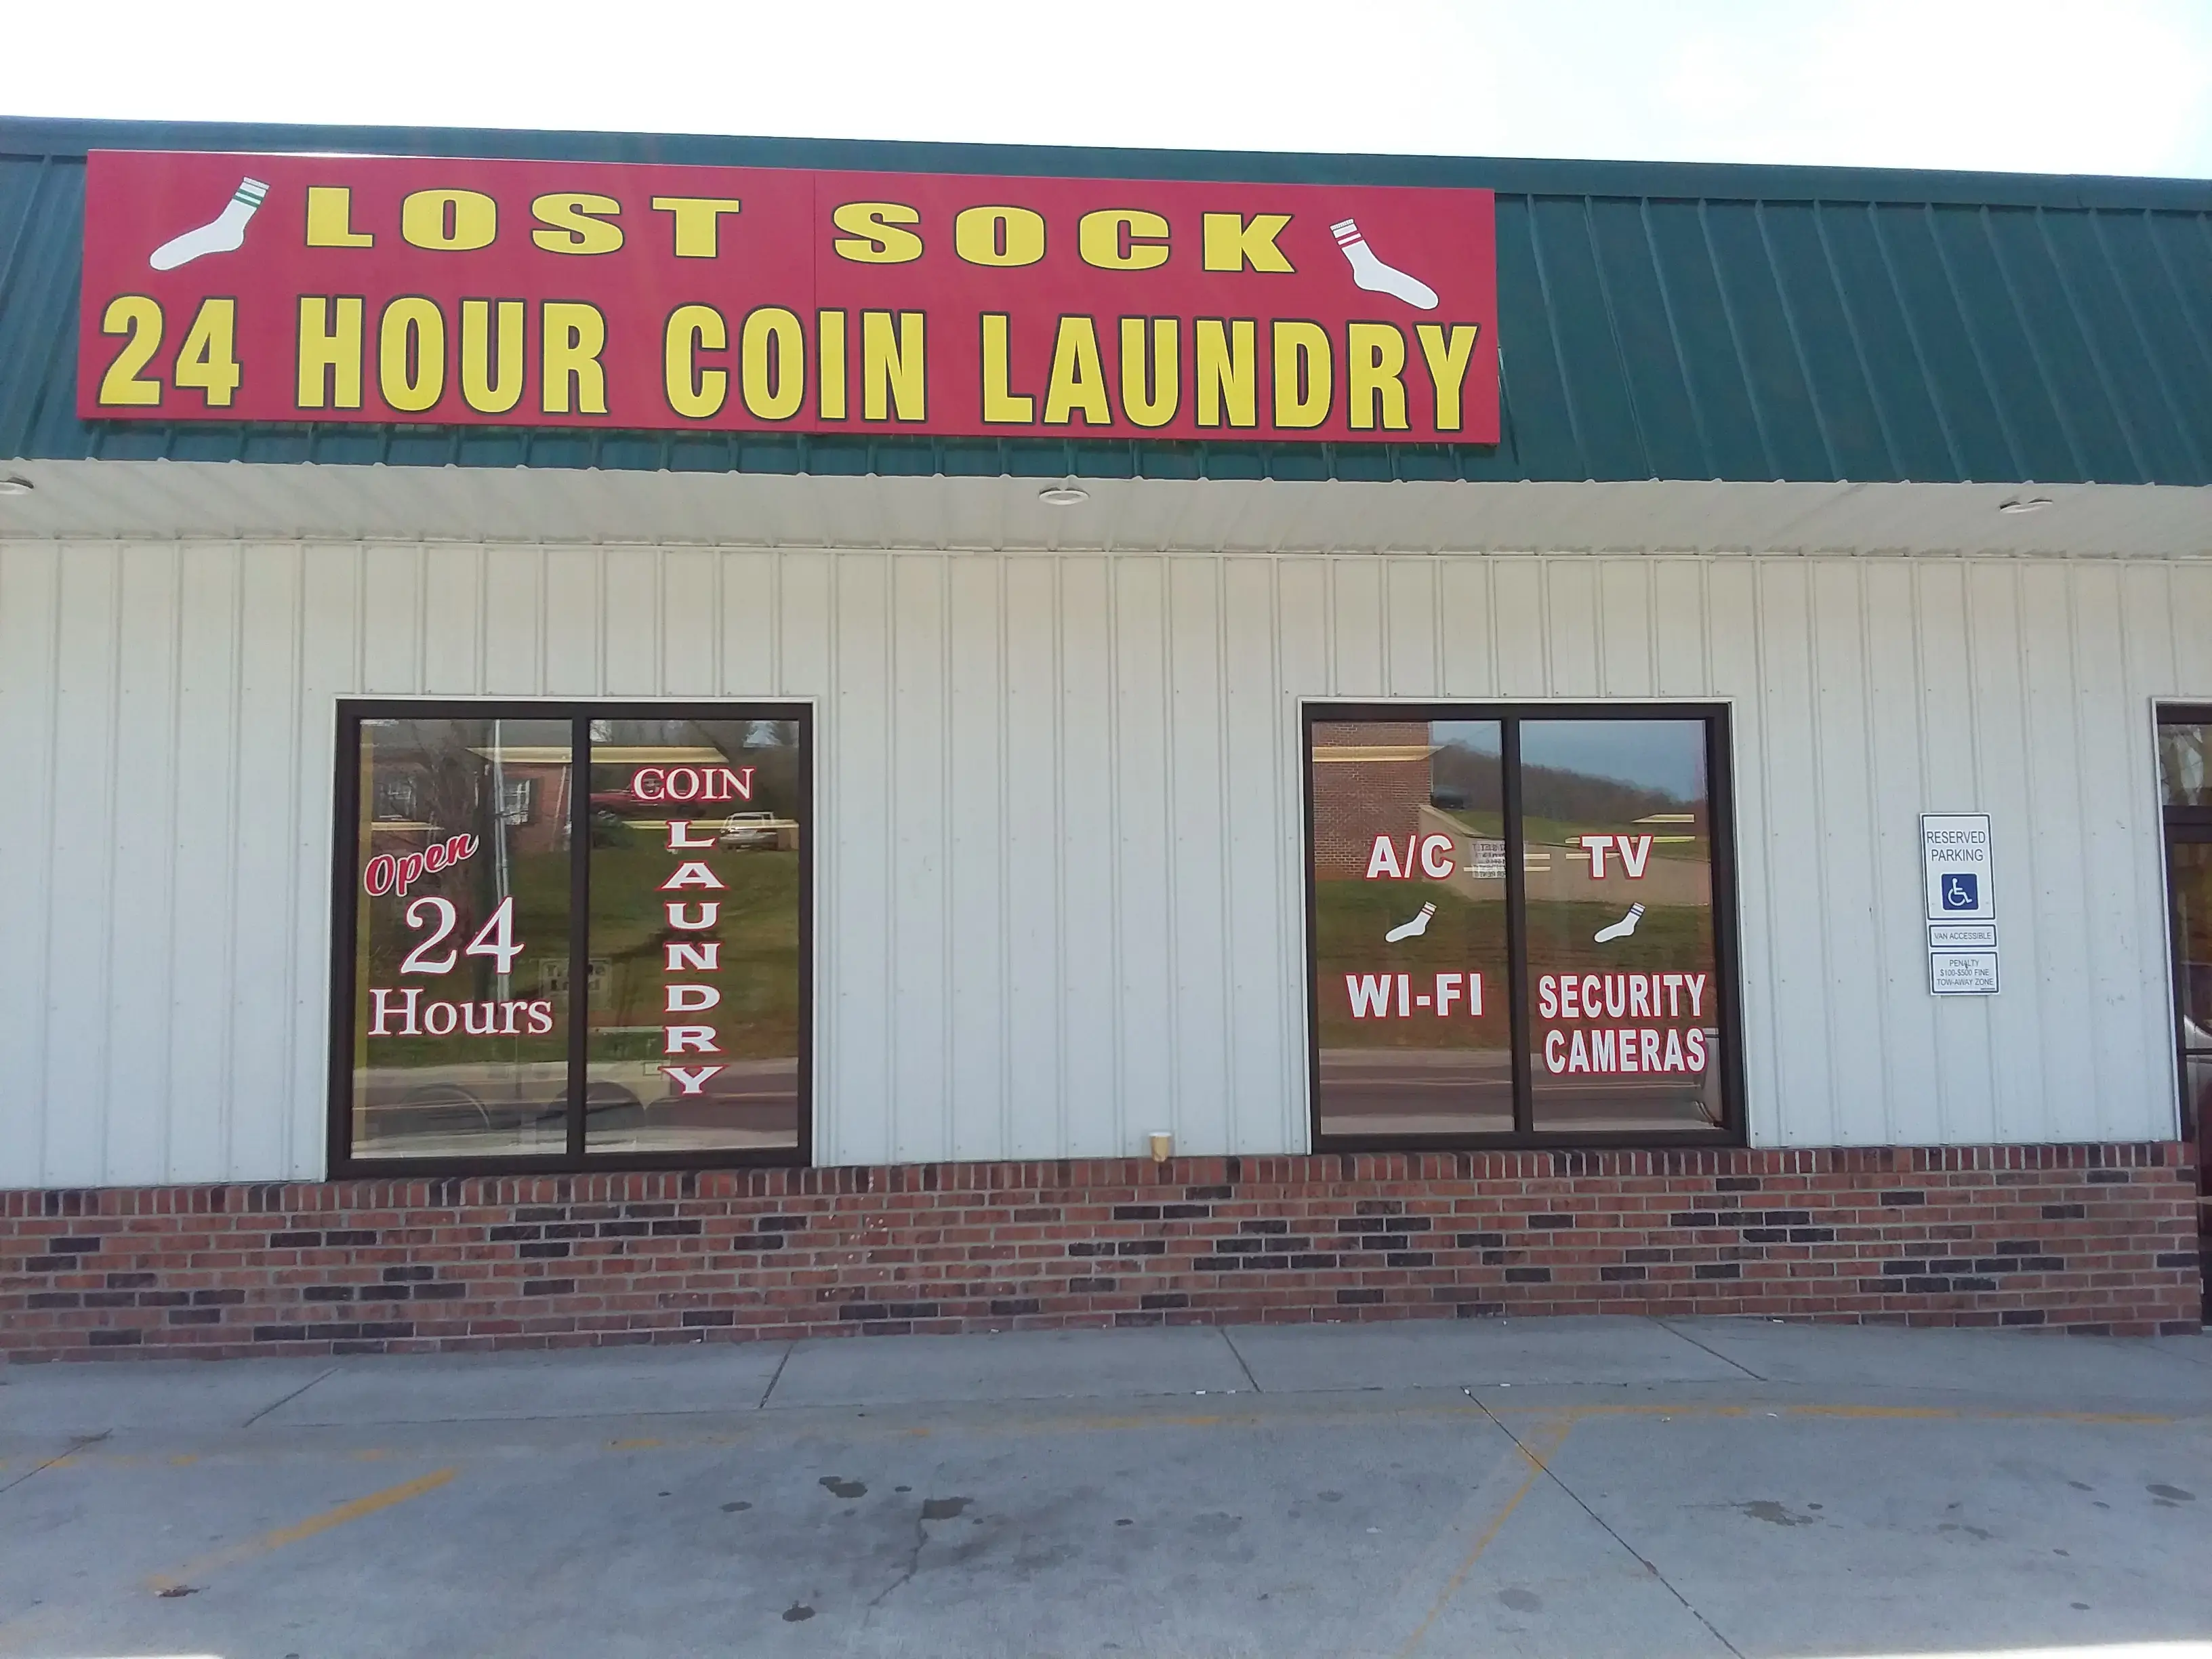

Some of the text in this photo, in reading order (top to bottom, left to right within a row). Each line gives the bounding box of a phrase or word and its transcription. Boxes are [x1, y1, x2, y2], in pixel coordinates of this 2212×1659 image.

[304, 184, 1296, 274] LOST SOCK
[97, 293, 1481, 433] 24 HOUR COIN LAUNDRY
[632, 767, 755, 801] COIN
[1365, 834, 1456, 881] A/C
[1580, 833, 1654, 880] TV
[1926, 831, 1986, 844] RESERVED
[1931, 848, 1984, 862] PARKING
[364, 832, 479, 897] Open
[399, 895, 525, 976] 24
[657, 819, 728, 1096] LAUNDRY
[1933, 932, 1992, 940] VAN ACCESSIBLE
[1937, 978, 1994, 986] TOW-AWAY ZONE
[1940, 968, 1990, 977] $100-$500 FINE
[1949, 959, 1980, 967] PENALTY
[367, 987, 553, 1036] Hours
[1345, 972, 1485, 1019] WI-FI
[1538, 973, 1707, 1019] SECURITY
[1543, 1027, 1707, 1074] CAMERAS
